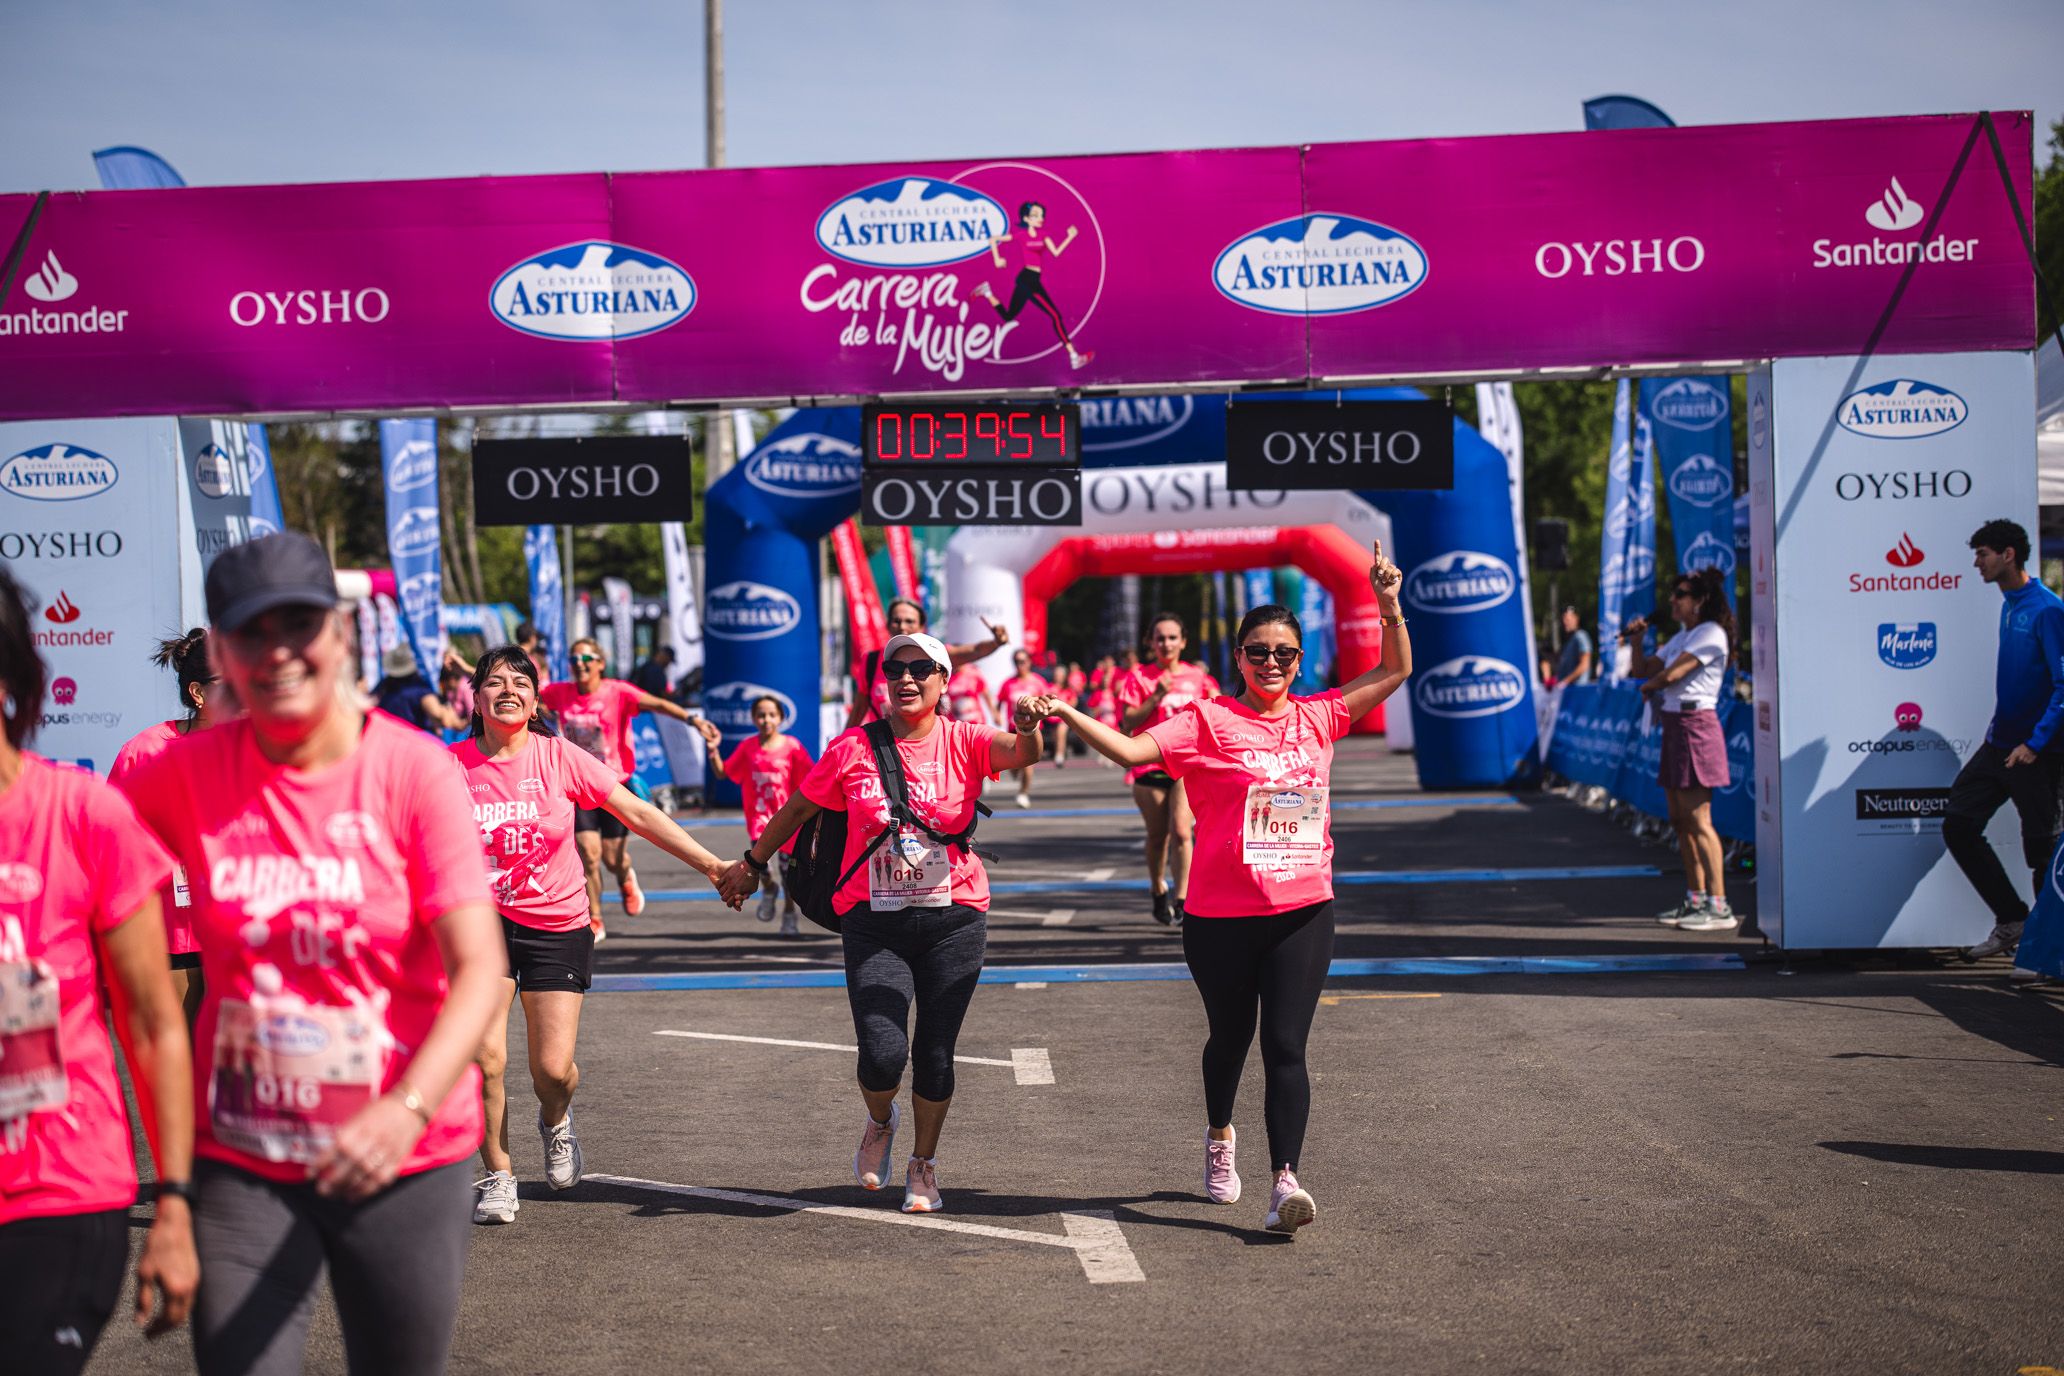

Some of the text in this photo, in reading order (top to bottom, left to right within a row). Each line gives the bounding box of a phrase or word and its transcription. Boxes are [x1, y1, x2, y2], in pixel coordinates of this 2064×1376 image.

[859, 204, 988, 219] CENTRAL LECHERA
[832, 212, 993, 247] ASTURIANA
[1262, 245, 1404, 261] CENTRAL LECHERA
[1534, 235, 1706, 279] OYSHO
[1812, 233, 1980, 268] Santander
[537, 272, 673, 287] CENTRAL LECHERA
[1230, 253, 1411, 291] ASTURIANA
[506, 280, 680, 317] ASTURIANA
[800, 262, 960, 313] Carrera
[0, 304, 129, 336] antander
[228, 286, 390, 327] OYSHO
[839, 300, 1020, 383] de la Mujer
[1078, 397, 1176, 427] RIANA
[1846, 402, 1959, 425] ASTURIANA
[876, 412, 1066, 459] 00:39:54
[1262, 430, 1421, 465] OYSHO
[8, 465, 109, 488] ASTURIANA
[507, 463, 660, 500] OYSHO
[1835, 470, 1973, 501] OYSHO
[871, 478, 1073, 520] OYSHO
[0, 530, 123, 560] OYSHO
[1849, 571, 1963, 593] Santander
[1232, 733, 1265, 744] OYSHO
[1847, 737, 1973, 756] octopus energy
[1242, 746, 1310, 774] CARRERA
[472, 800, 541, 824] ARRERA
[1269, 821, 1299, 834] 016
[1253, 852, 1277, 860] OYSHO
[894, 868, 924, 882] 016
